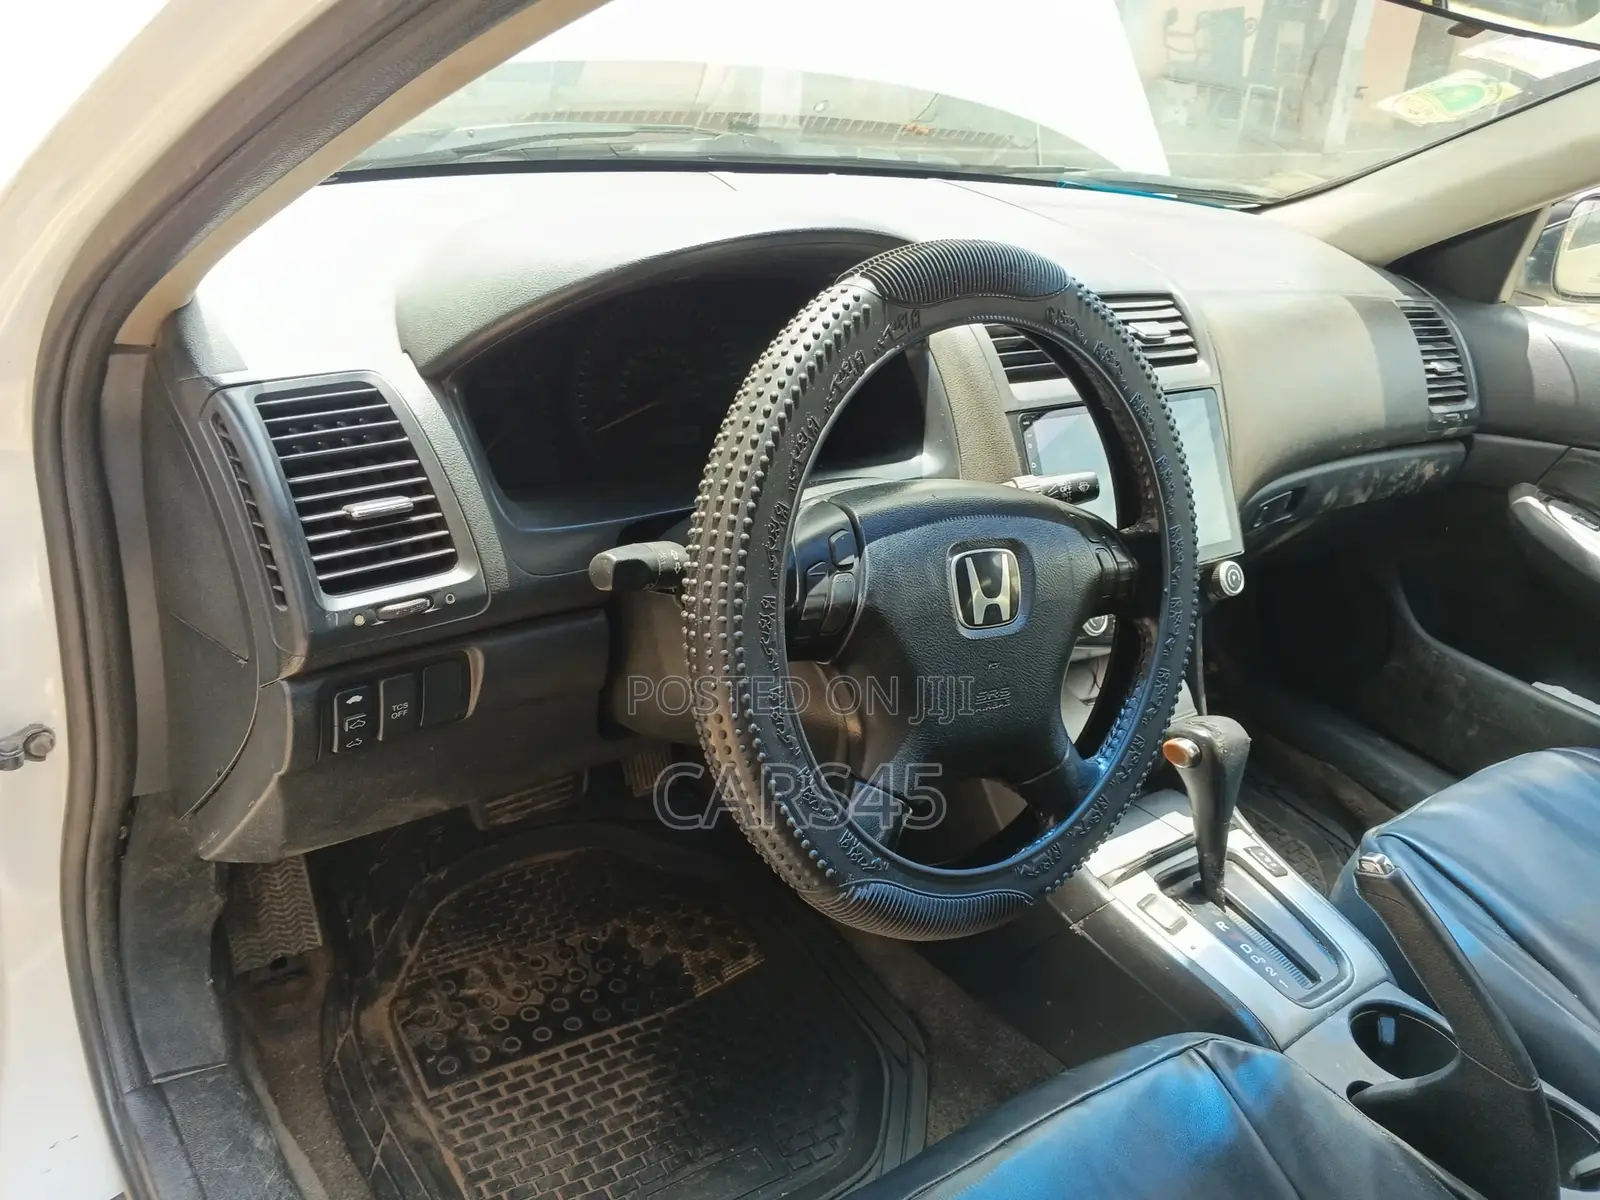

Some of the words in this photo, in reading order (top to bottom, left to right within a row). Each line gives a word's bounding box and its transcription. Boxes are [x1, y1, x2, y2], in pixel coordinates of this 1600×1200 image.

[392, 702, 409, 711] TCS
[391, 709, 409, 720] OFF
[1215, 920, 1230, 932] R
[1240, 943, 1252, 955] D
[1265, 966, 1277, 977] 2
